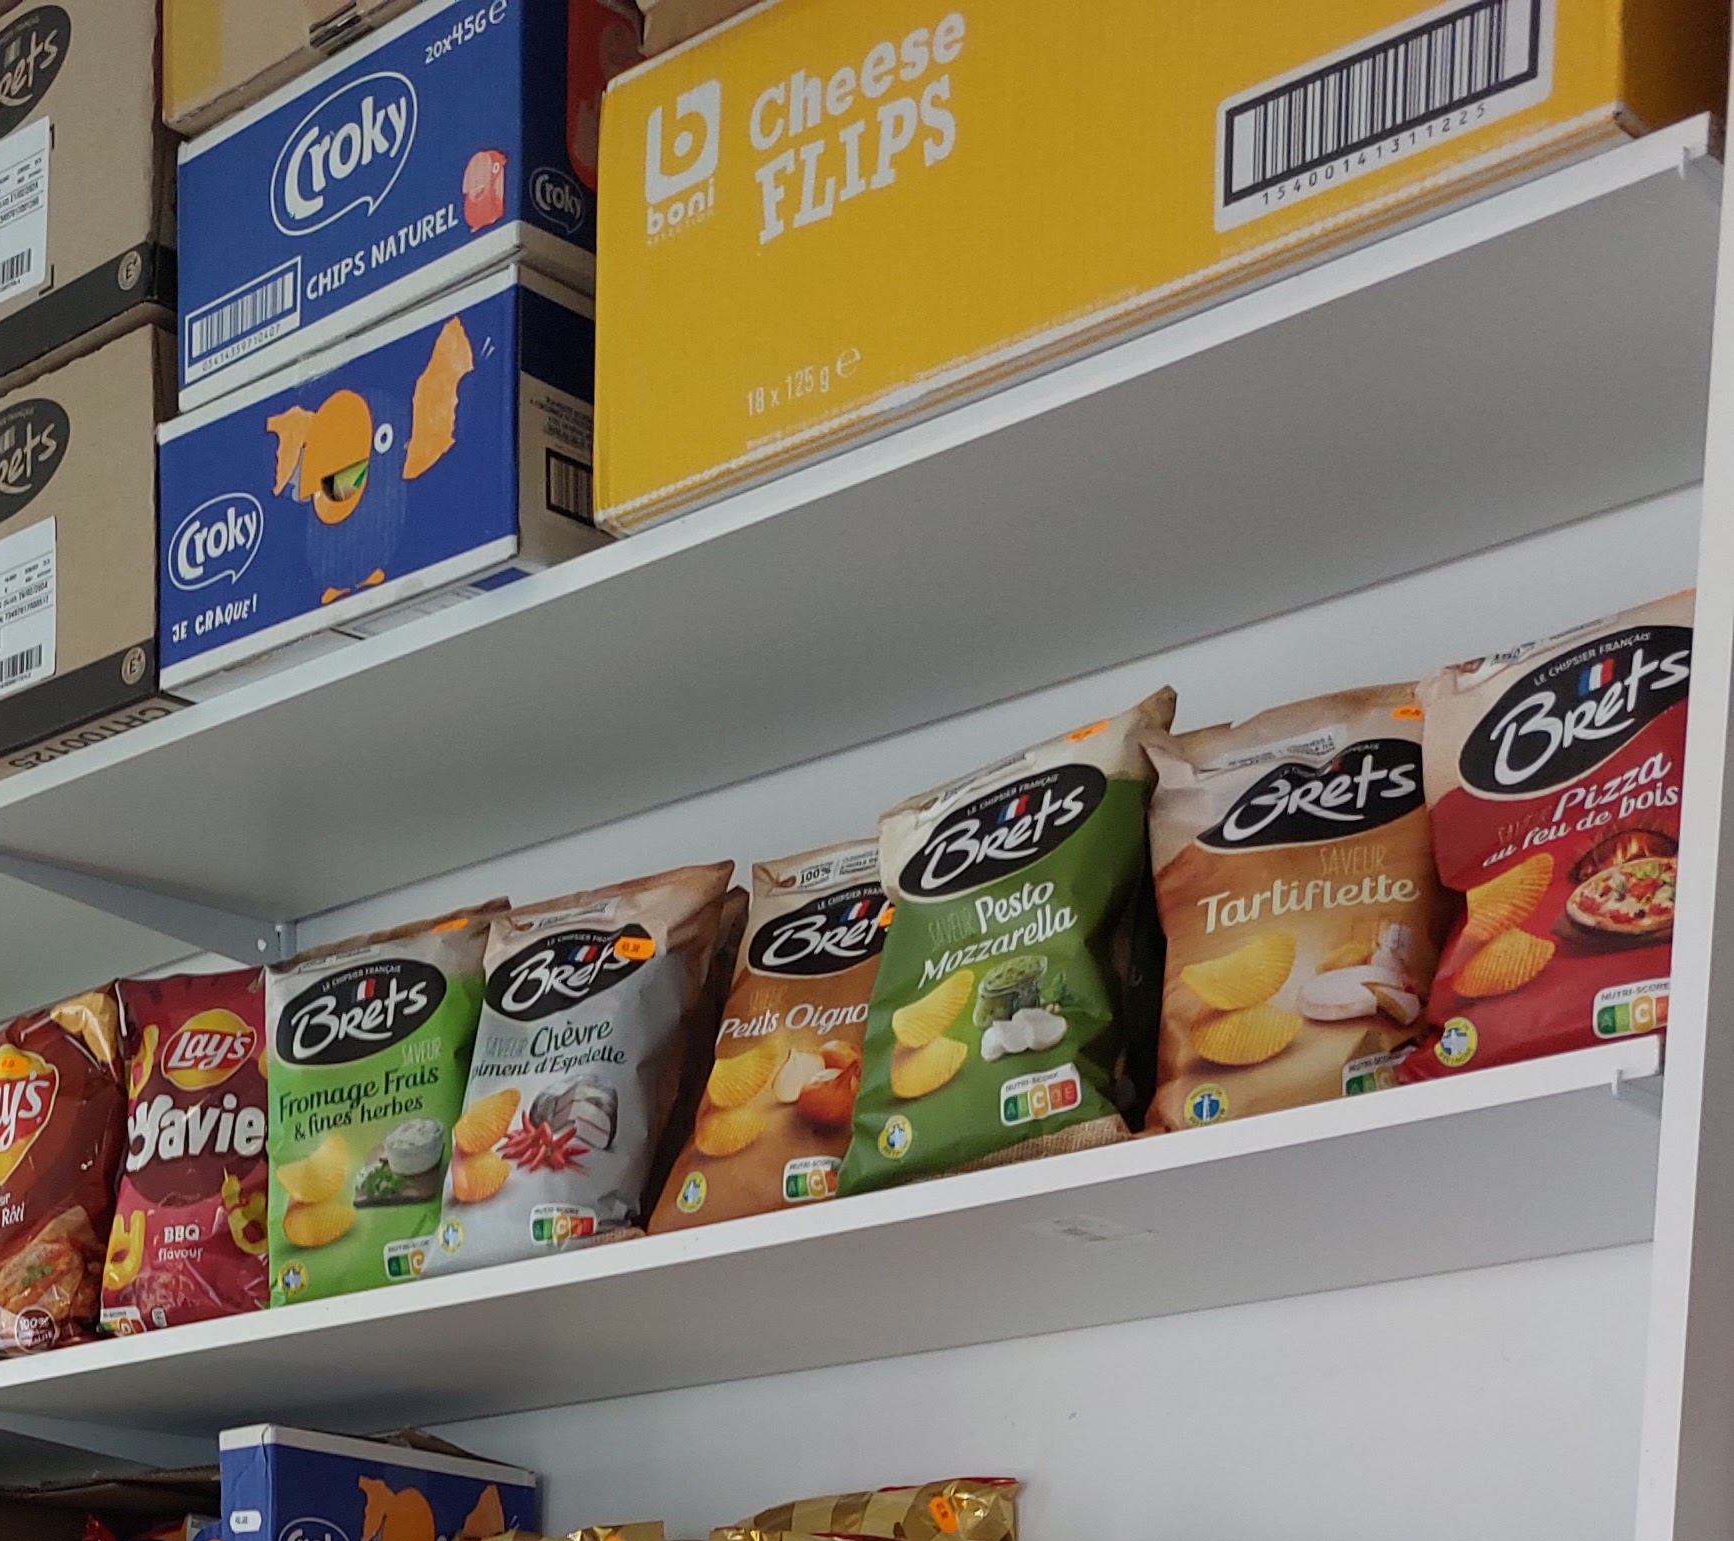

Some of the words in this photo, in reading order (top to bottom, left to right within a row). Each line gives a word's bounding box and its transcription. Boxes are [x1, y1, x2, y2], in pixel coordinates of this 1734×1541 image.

[748, 11, 968, 151] Cheese
[284, 96, 409, 219] Croky
[756, 77, 958, 245] FLIPS
[646, 184, 715, 238] boni
[307, 252, 365, 300] CHIPS
[370, 203, 460, 269] NATUREL
[177, 511, 256, 580] Croky
[1491, 648, 1689, 782] Brets
[1223, 753, 1417, 839] Brets
[1521, 821, 1568, 860] feu
[1575, 805, 1610, 834] de
[1618, 780, 1678, 820] bois
[1556, 751, 1671, 820] Pizza
[922, 784, 1084, 892] Brets
[975, 878, 1055, 931] Pesto
[1197, 871, 1418, 935] Tartiflette
[919, 906, 1077, 992] Mozzarella
[168, 1028, 254, 1071] Lay's
[289, 975, 428, 1059] Brets
[531, 1018, 613, 1056] Chèvre
[721, 1008, 781, 1043] Petits
[789, 1000, 866, 1030] Oigno
[279, 1077, 378, 1121] Fromage
[383, 1063, 438, 1096] Frais
[535, 1047, 627, 1076] d'Espelette
[308, 1110, 353, 1137] fines
[359, 1094, 423, 1123] herbes
[164, 1225, 199, 1243] BBQ
